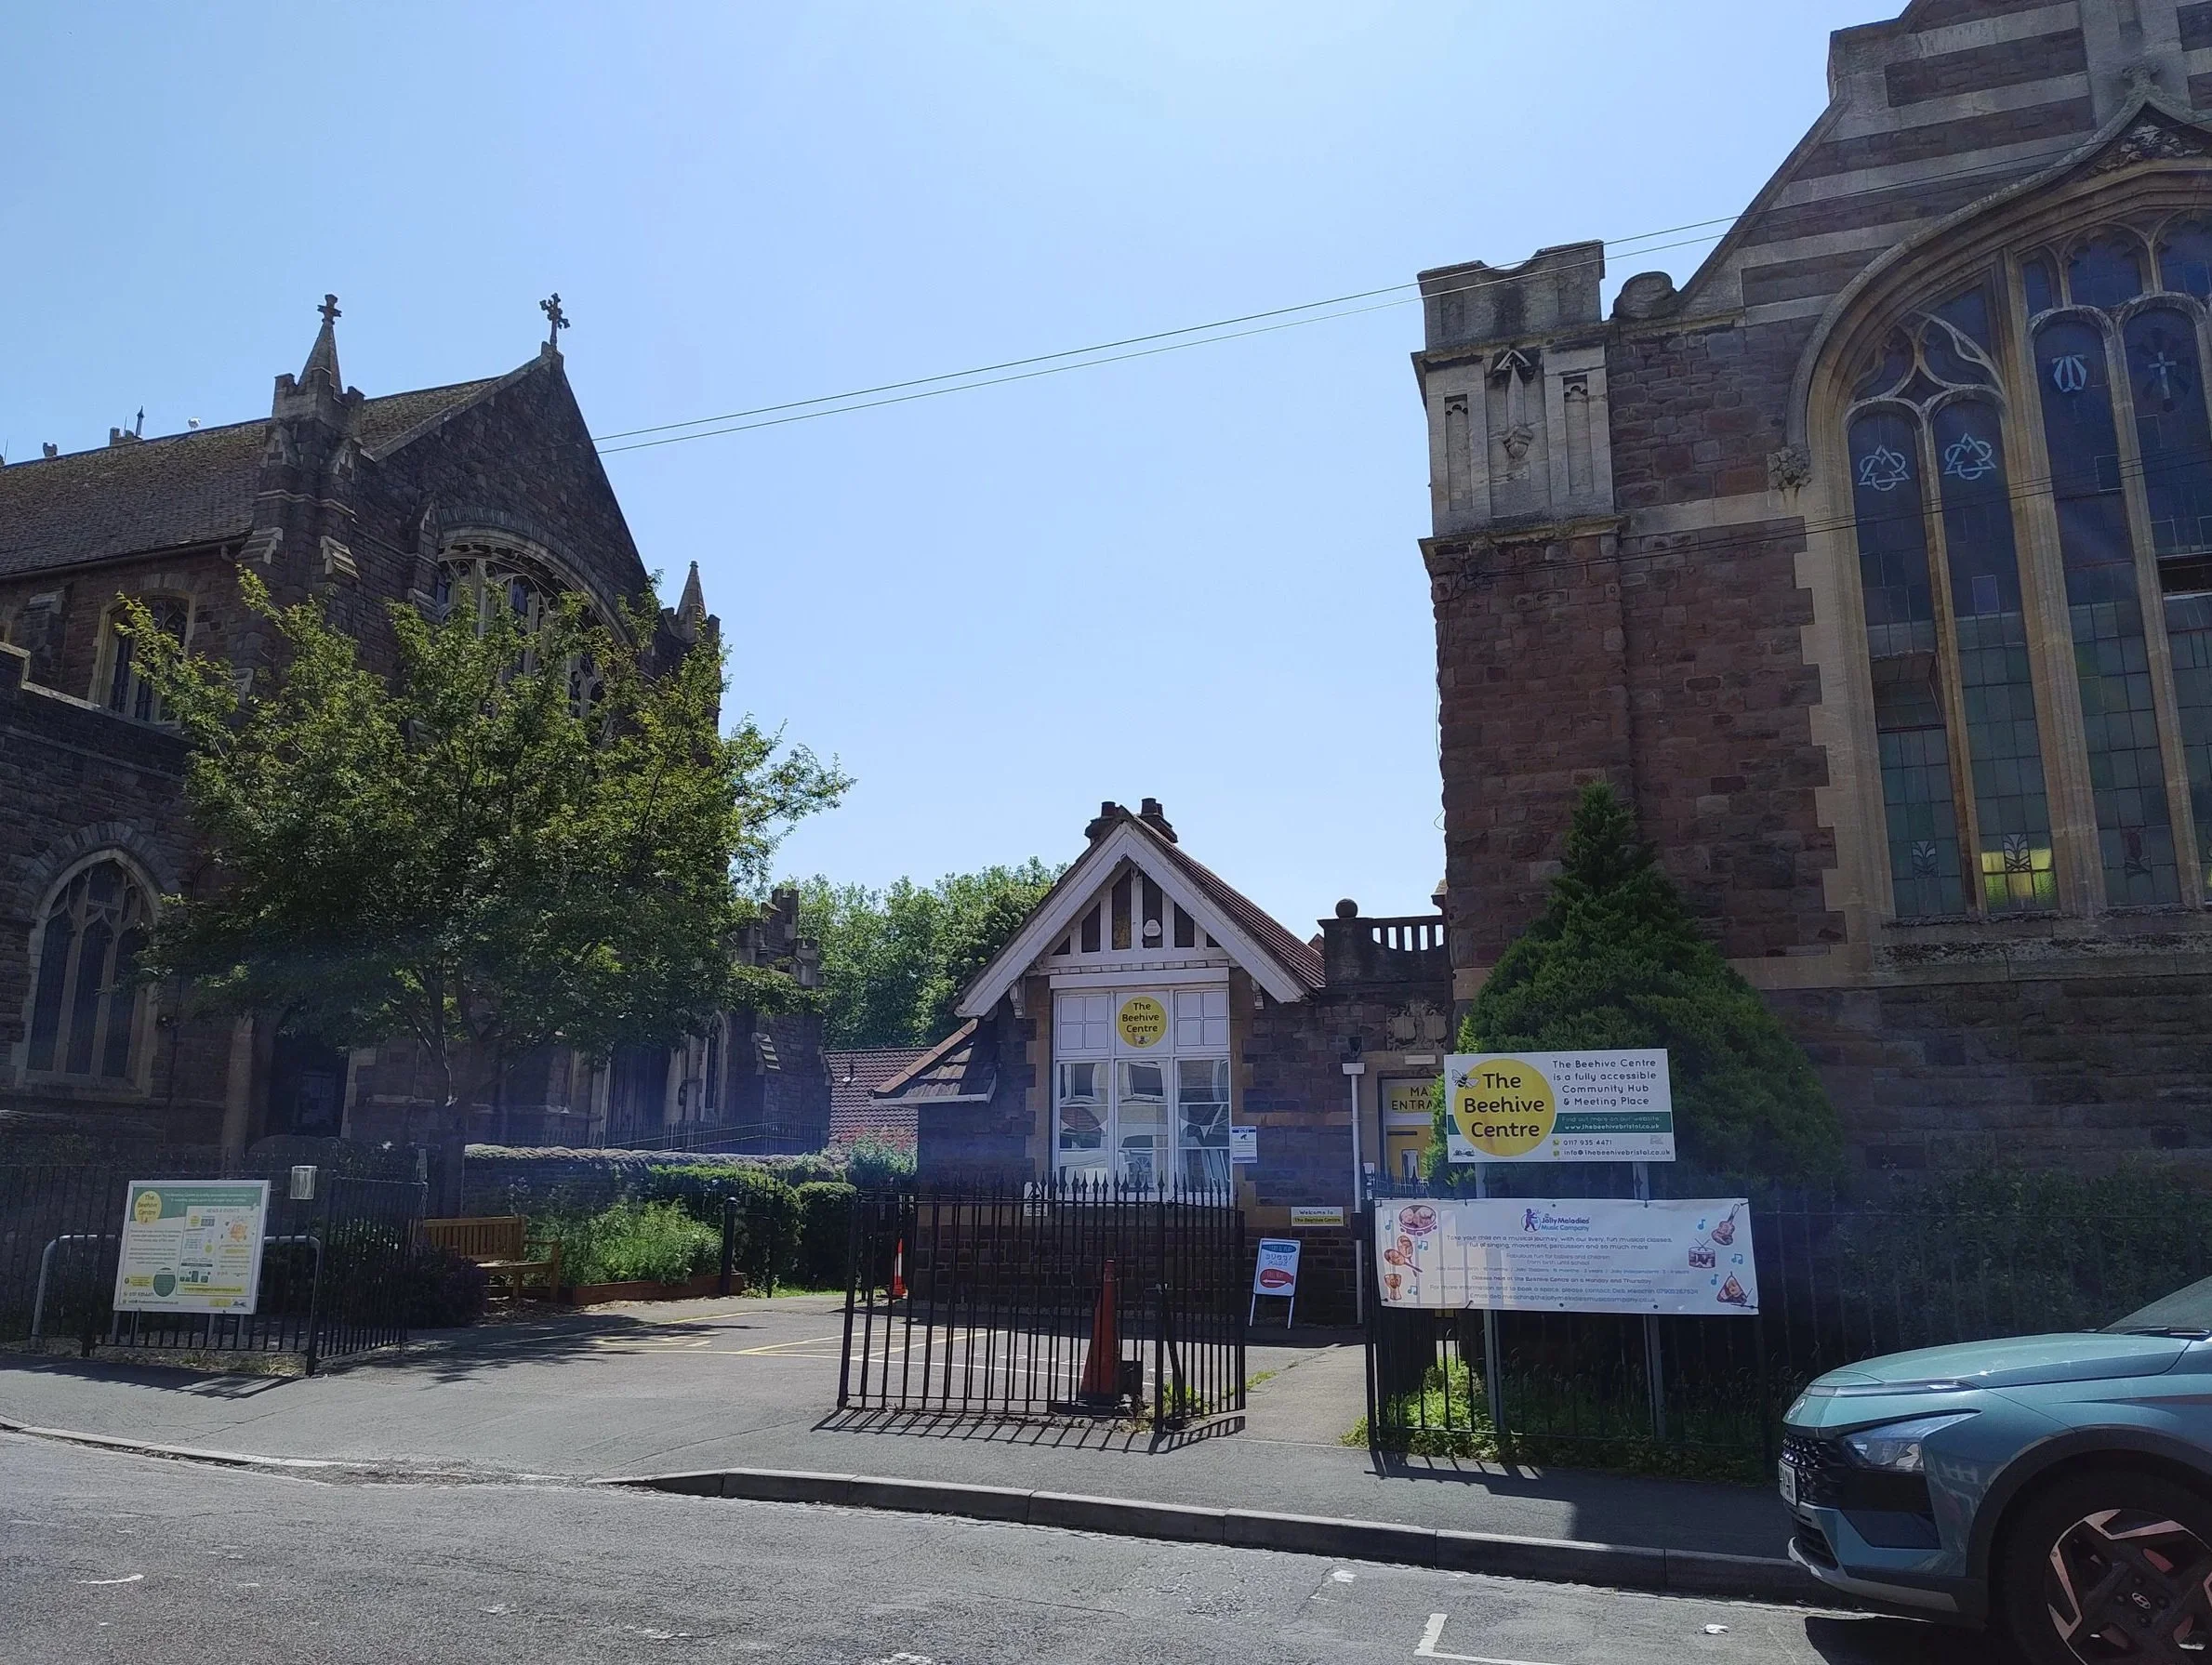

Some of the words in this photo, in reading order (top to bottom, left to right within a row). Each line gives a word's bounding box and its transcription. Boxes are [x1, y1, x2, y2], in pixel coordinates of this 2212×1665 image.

[1132, 1002, 1151, 1011] The
[1122, 1012, 1159, 1022] Beehive
[1126, 1024, 1158, 1033] Centre
[1575, 1060, 1616, 1068] Beehive
[1620, 1059, 1656, 1067] Centre
[1482, 1072, 1521, 1089] The
[1575, 1073, 1596, 1082] fully
[1600, 1071, 1657, 1080] accessible
[1410, 1086, 1429, 1097] MA
[1562, 1085, 1623, 1094] Community
[1627, 1084, 1649, 1092] Hub
[1391, 1100, 1433, 1110] ENTRA
[1464, 1096, 1544, 1113] Beehive
[1574, 1097, 1616, 1107] Meeting
[1621, 1096, 1649, 1105] Place
[1471, 1122, 1540, 1137] Centre
